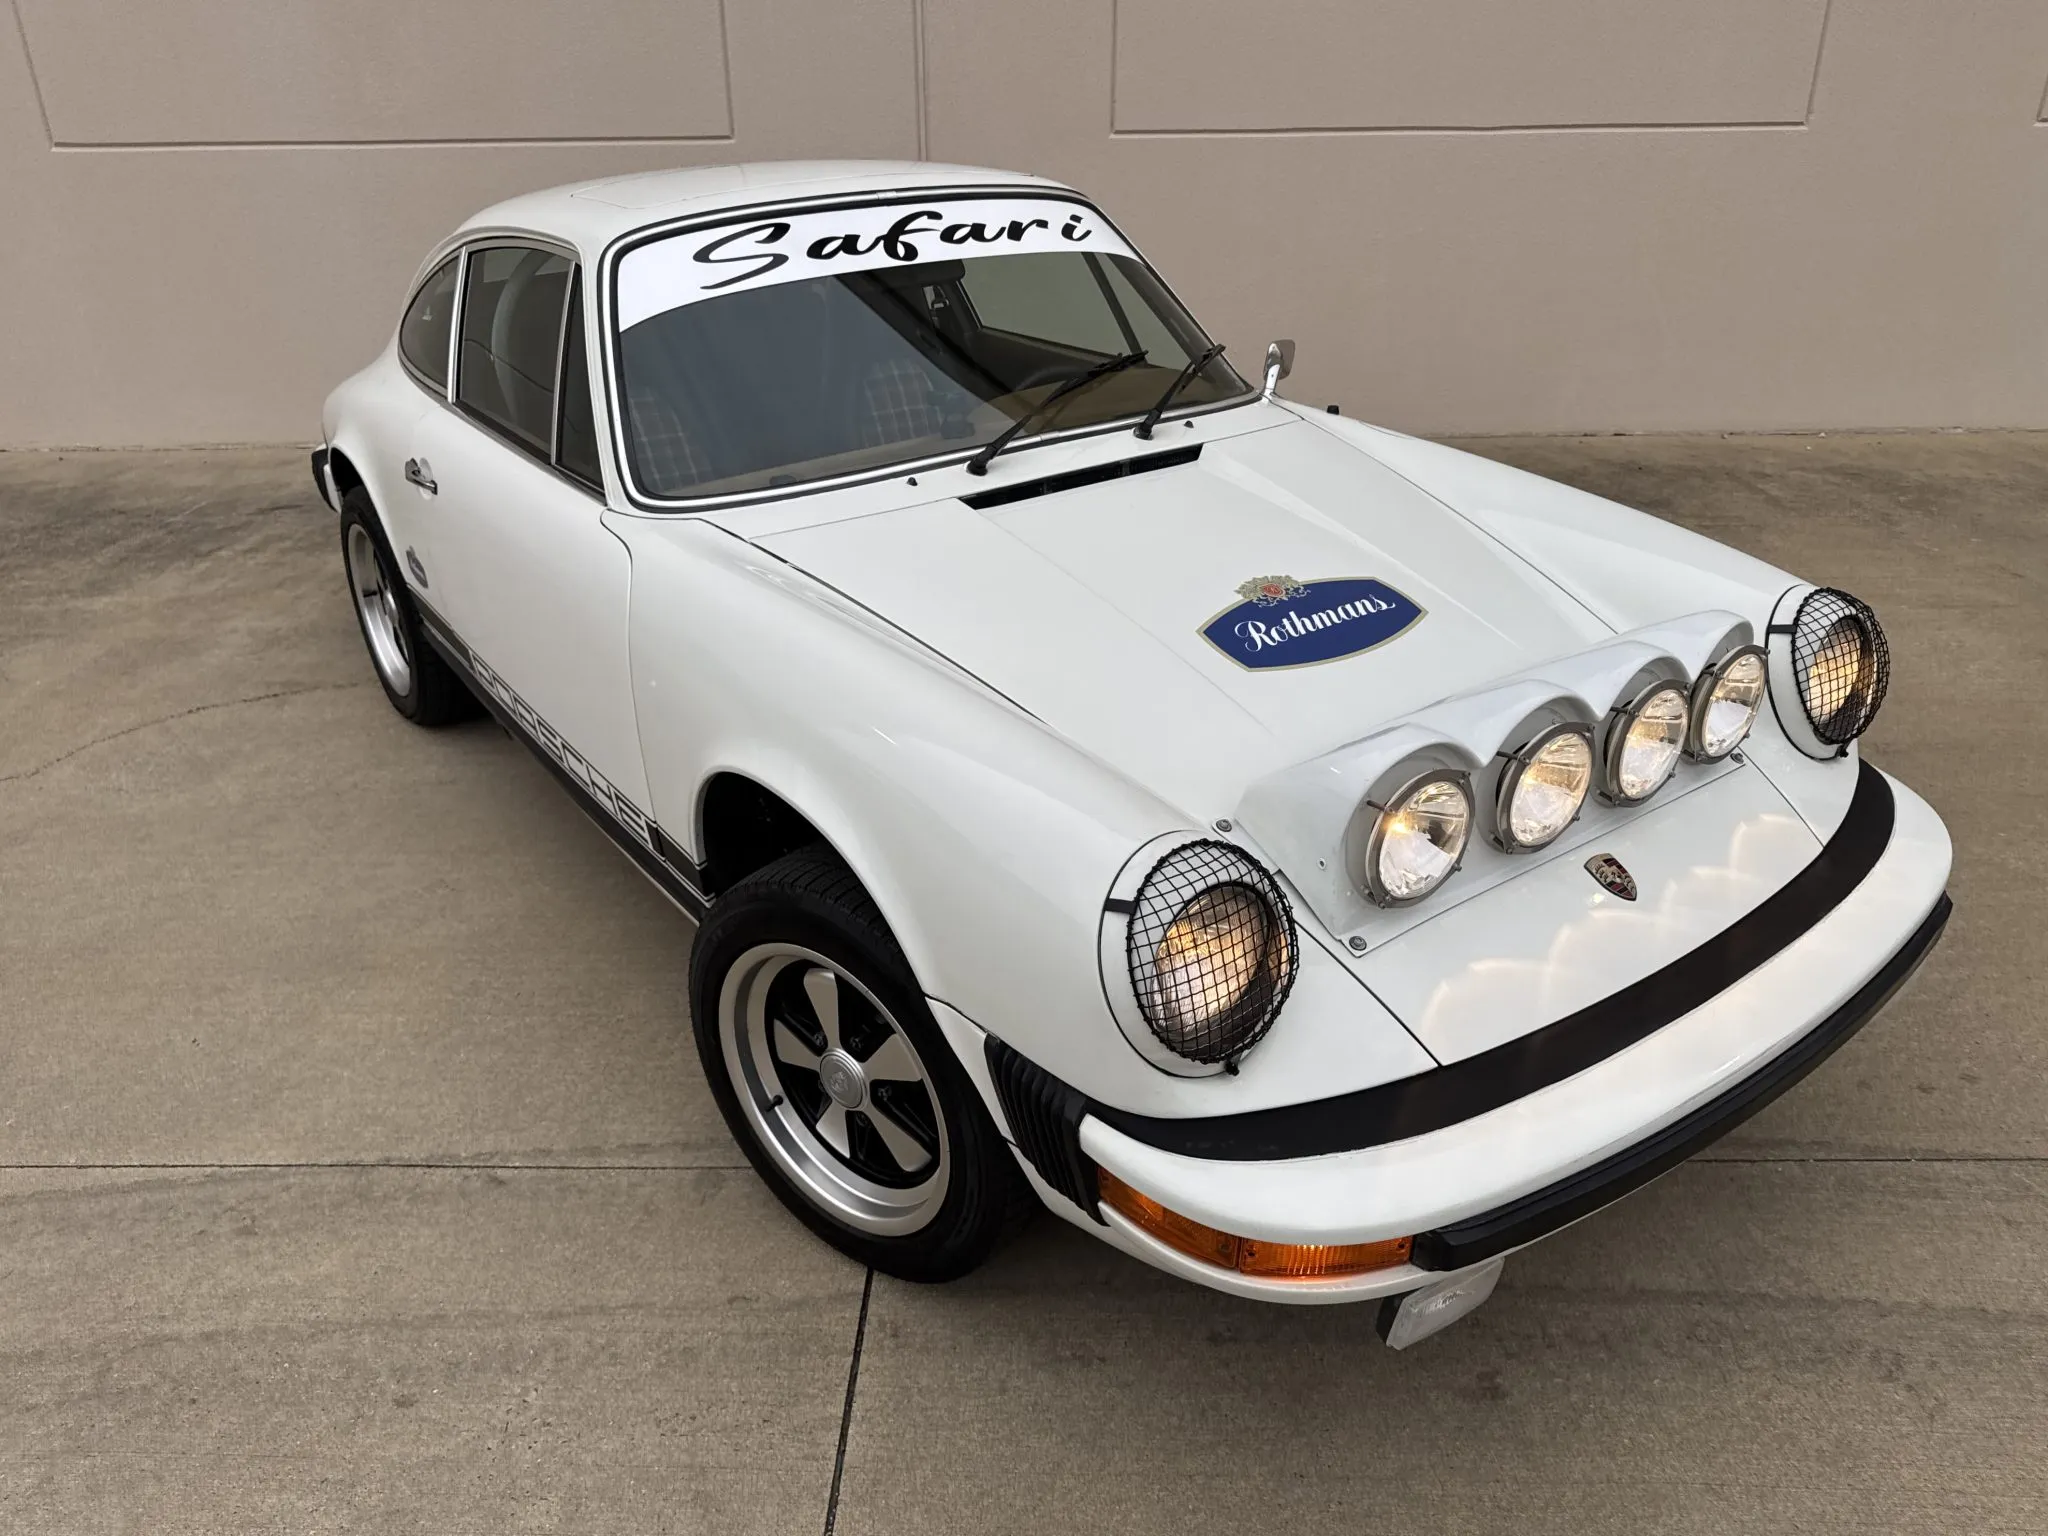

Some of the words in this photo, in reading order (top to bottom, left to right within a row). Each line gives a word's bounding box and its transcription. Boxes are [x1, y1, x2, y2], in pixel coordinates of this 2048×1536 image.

[692, 211, 1092, 290] Safari
[1234, 595, 1395, 652] Rothmans
[470, 651, 653, 848] PORSCHE
